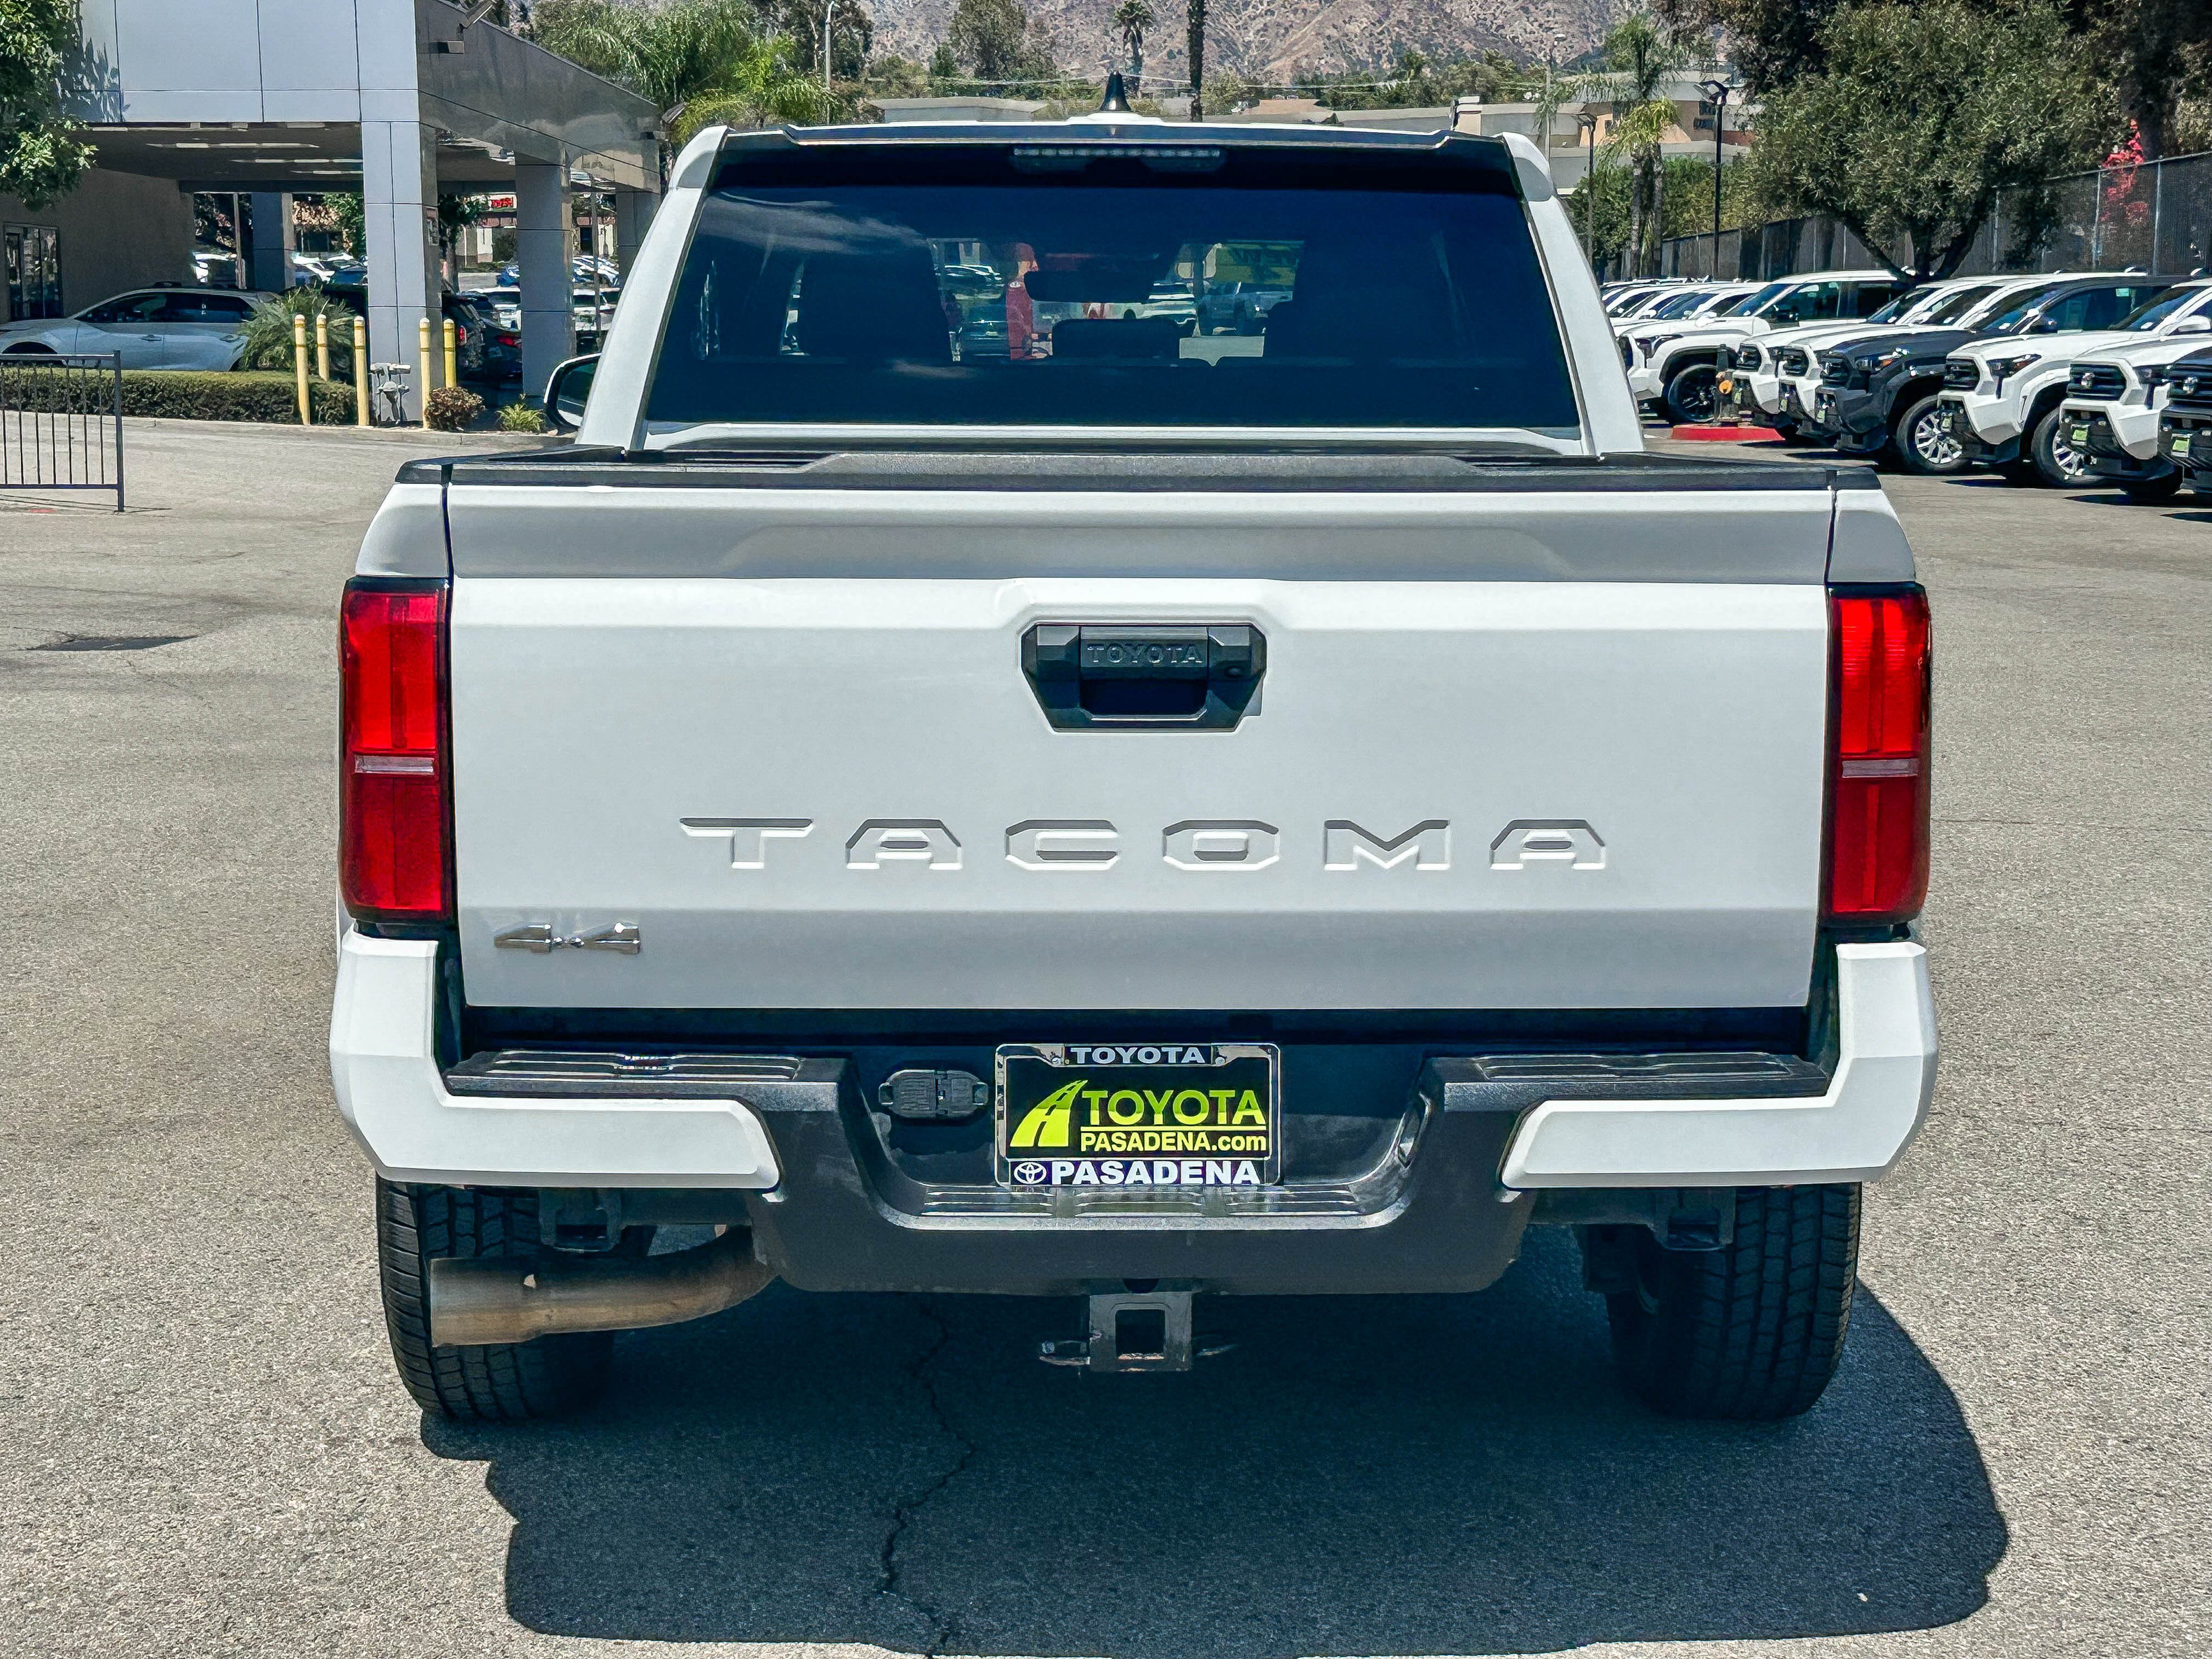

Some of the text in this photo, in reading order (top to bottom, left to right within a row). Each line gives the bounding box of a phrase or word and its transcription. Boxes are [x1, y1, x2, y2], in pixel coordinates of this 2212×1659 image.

[1087, 643, 1203, 663] TOYOTA
[679, 817, 1606, 871] TACOMA
[1070, 1047, 1205, 1064] TOYOTA
[1082, 1089, 1267, 1125] TOYOTA
[1080, 1132, 1267, 1152] PASADENA.com
[1052, 1160, 1261, 1185] PASADENA
